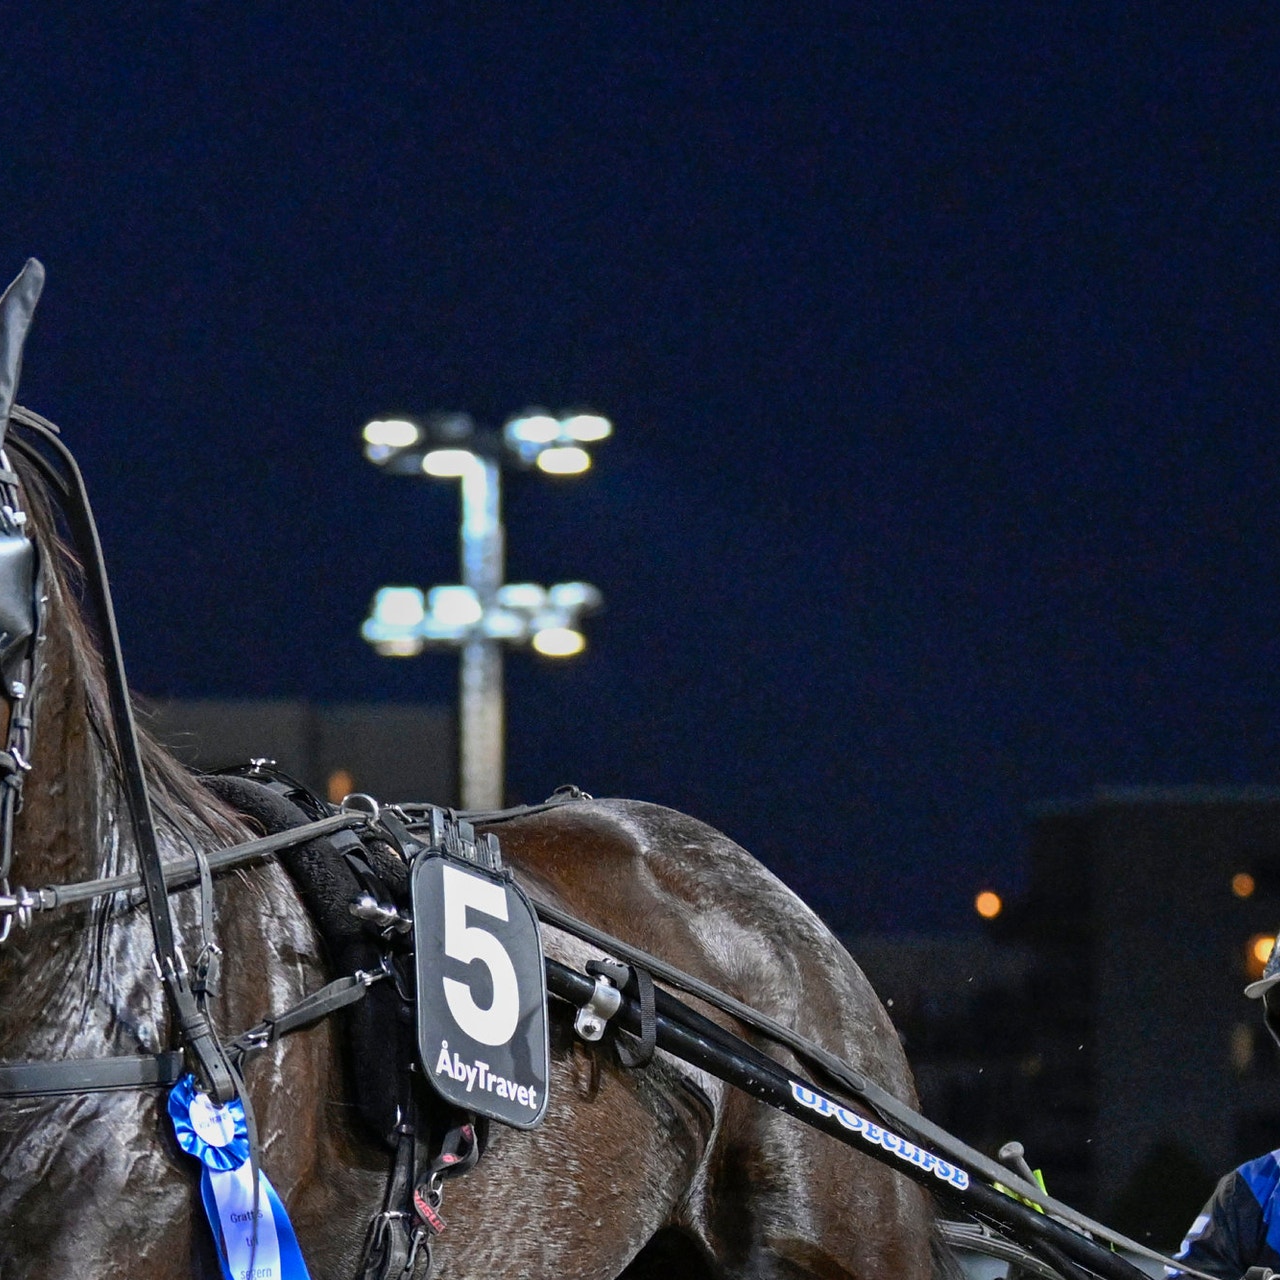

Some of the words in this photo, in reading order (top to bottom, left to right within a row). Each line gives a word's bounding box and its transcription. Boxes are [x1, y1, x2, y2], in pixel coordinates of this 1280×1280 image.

[442, 864, 520, 1046] 5
[434, 1040, 537, 1110] ÅbyTravet
[230, 1209, 264, 1223] Gratts
